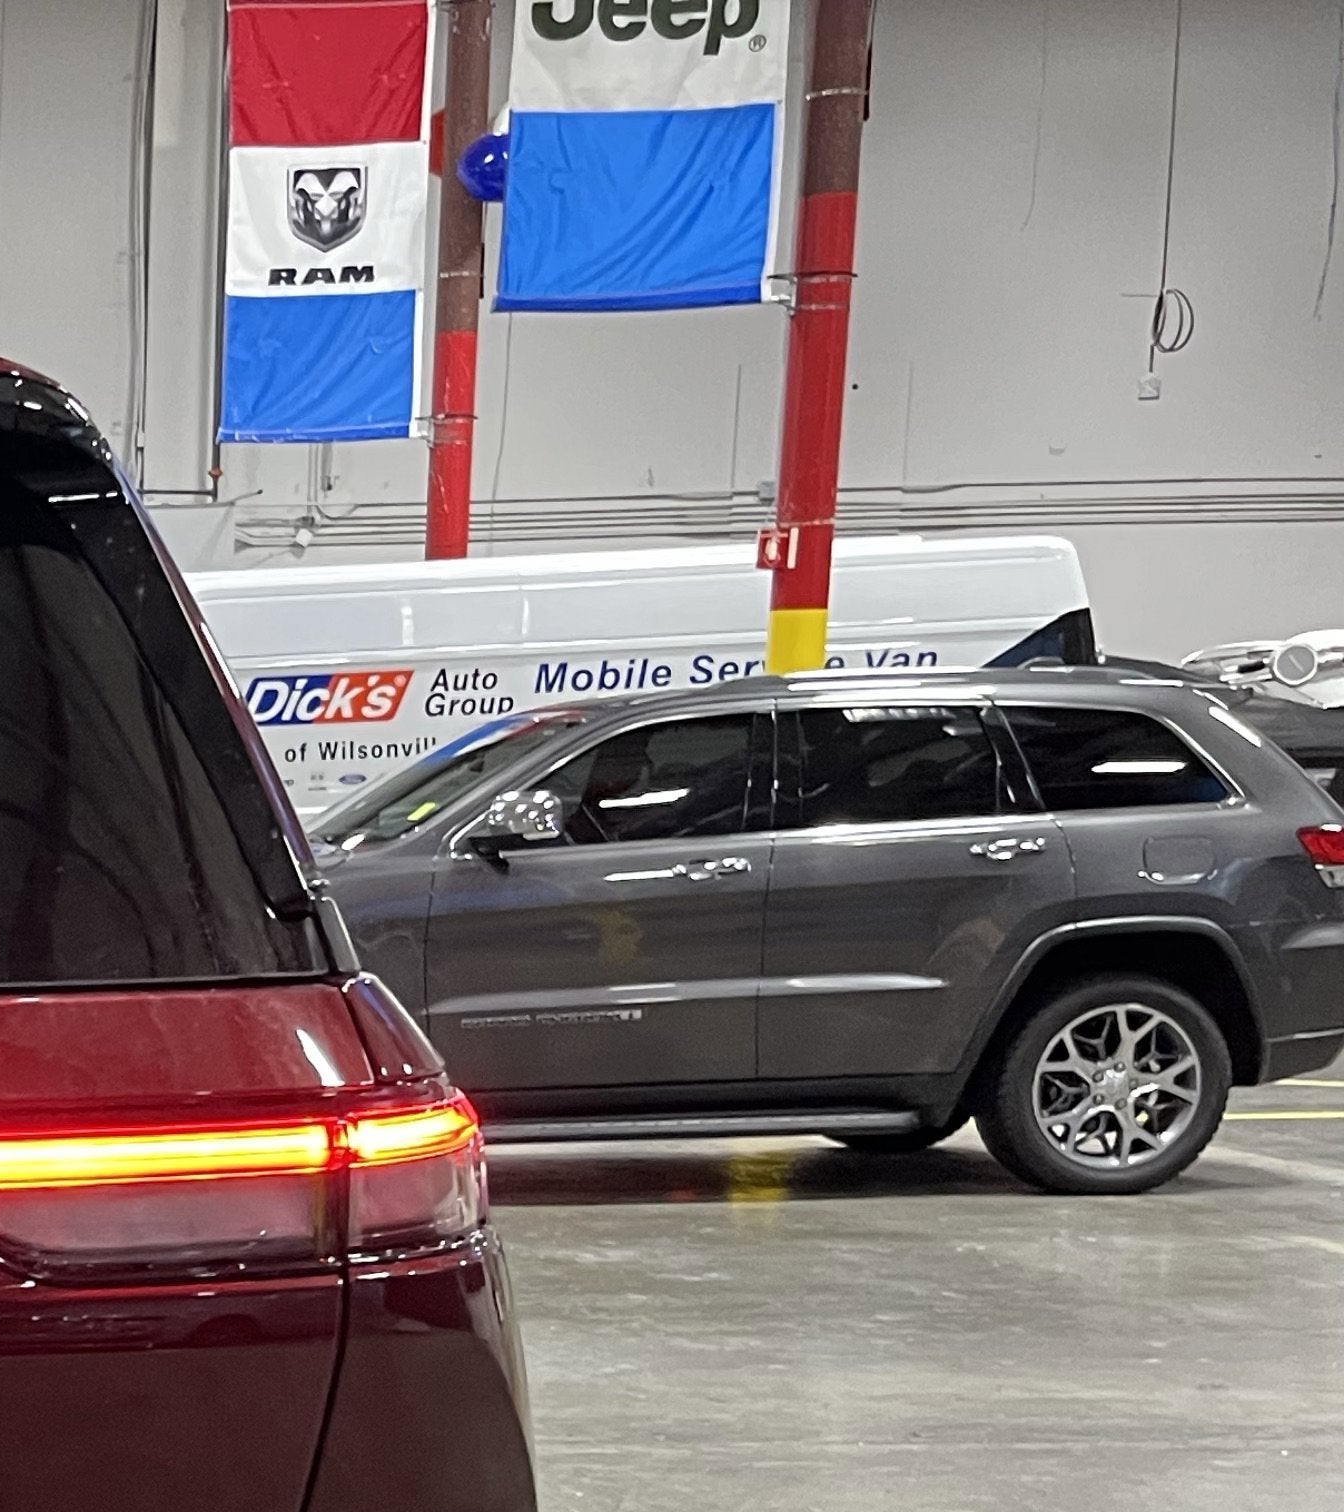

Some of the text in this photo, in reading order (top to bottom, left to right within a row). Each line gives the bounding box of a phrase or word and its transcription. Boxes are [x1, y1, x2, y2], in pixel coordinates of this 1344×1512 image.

[268, 265, 376, 286] RAM
[429, 667, 499, 692] Auto
[534, 656, 672, 694] Mobile
[248, 673, 399, 724] Dick's
[424, 692, 515, 718] Group
[284, 742, 307, 764] of
